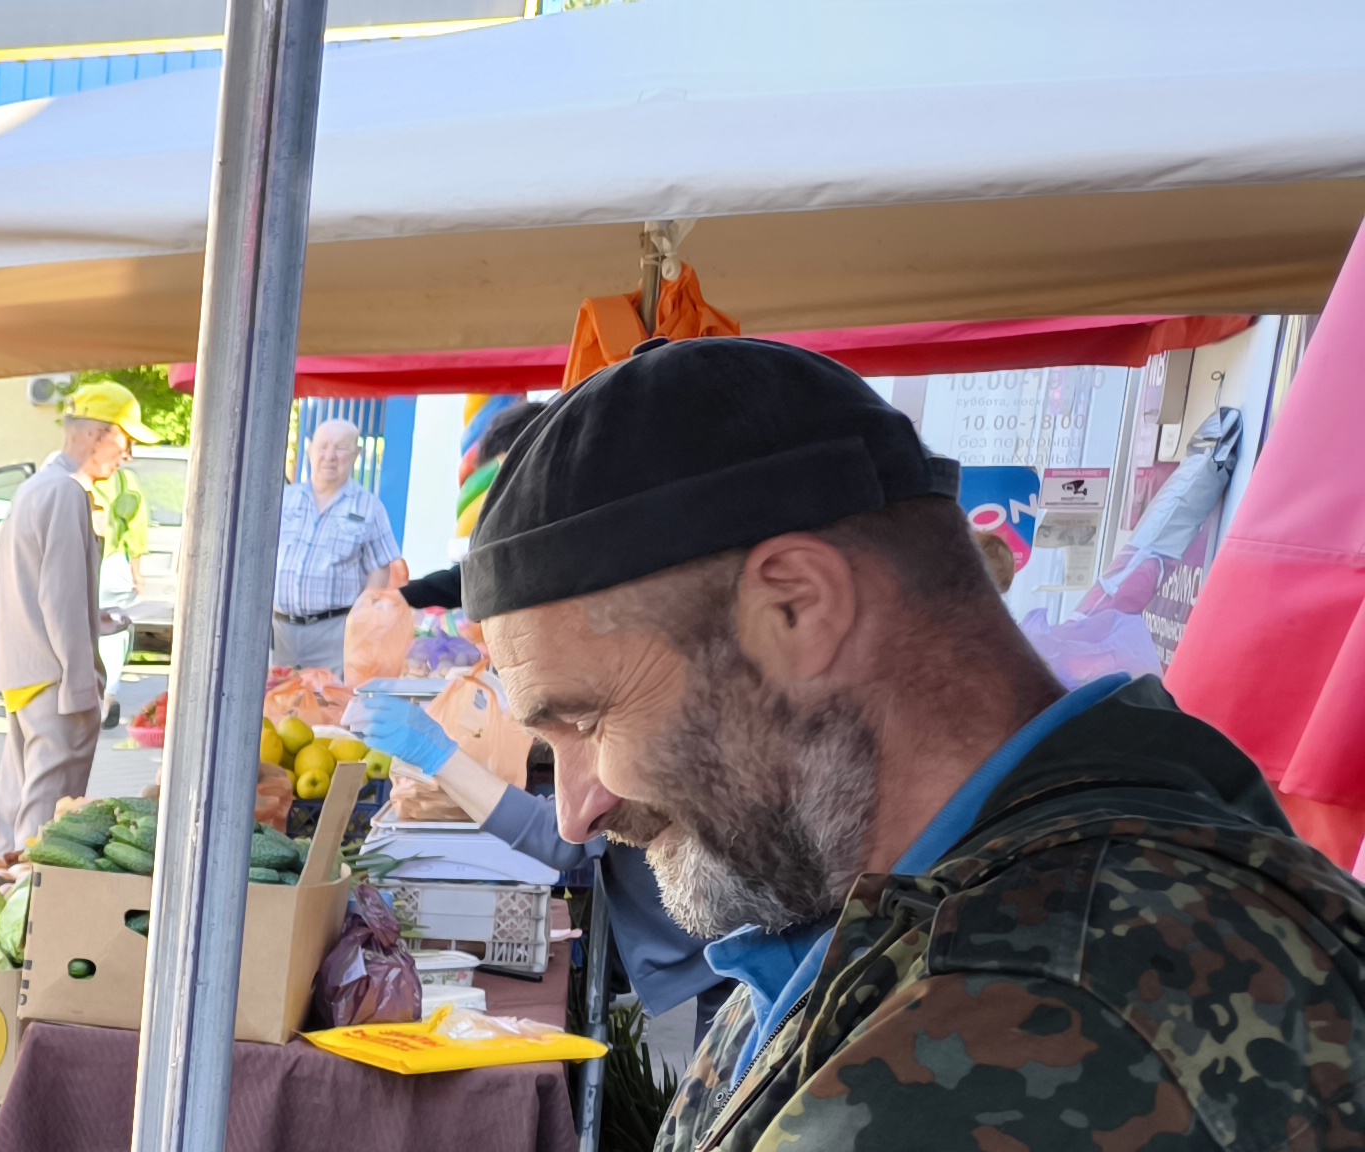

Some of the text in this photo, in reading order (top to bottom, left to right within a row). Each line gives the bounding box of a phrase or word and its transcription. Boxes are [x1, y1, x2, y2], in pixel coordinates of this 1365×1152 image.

[958, 435, 1081, 451] без перерыва
[958, 451, 986, 464] без
[968, 493, 1037, 533] ON
